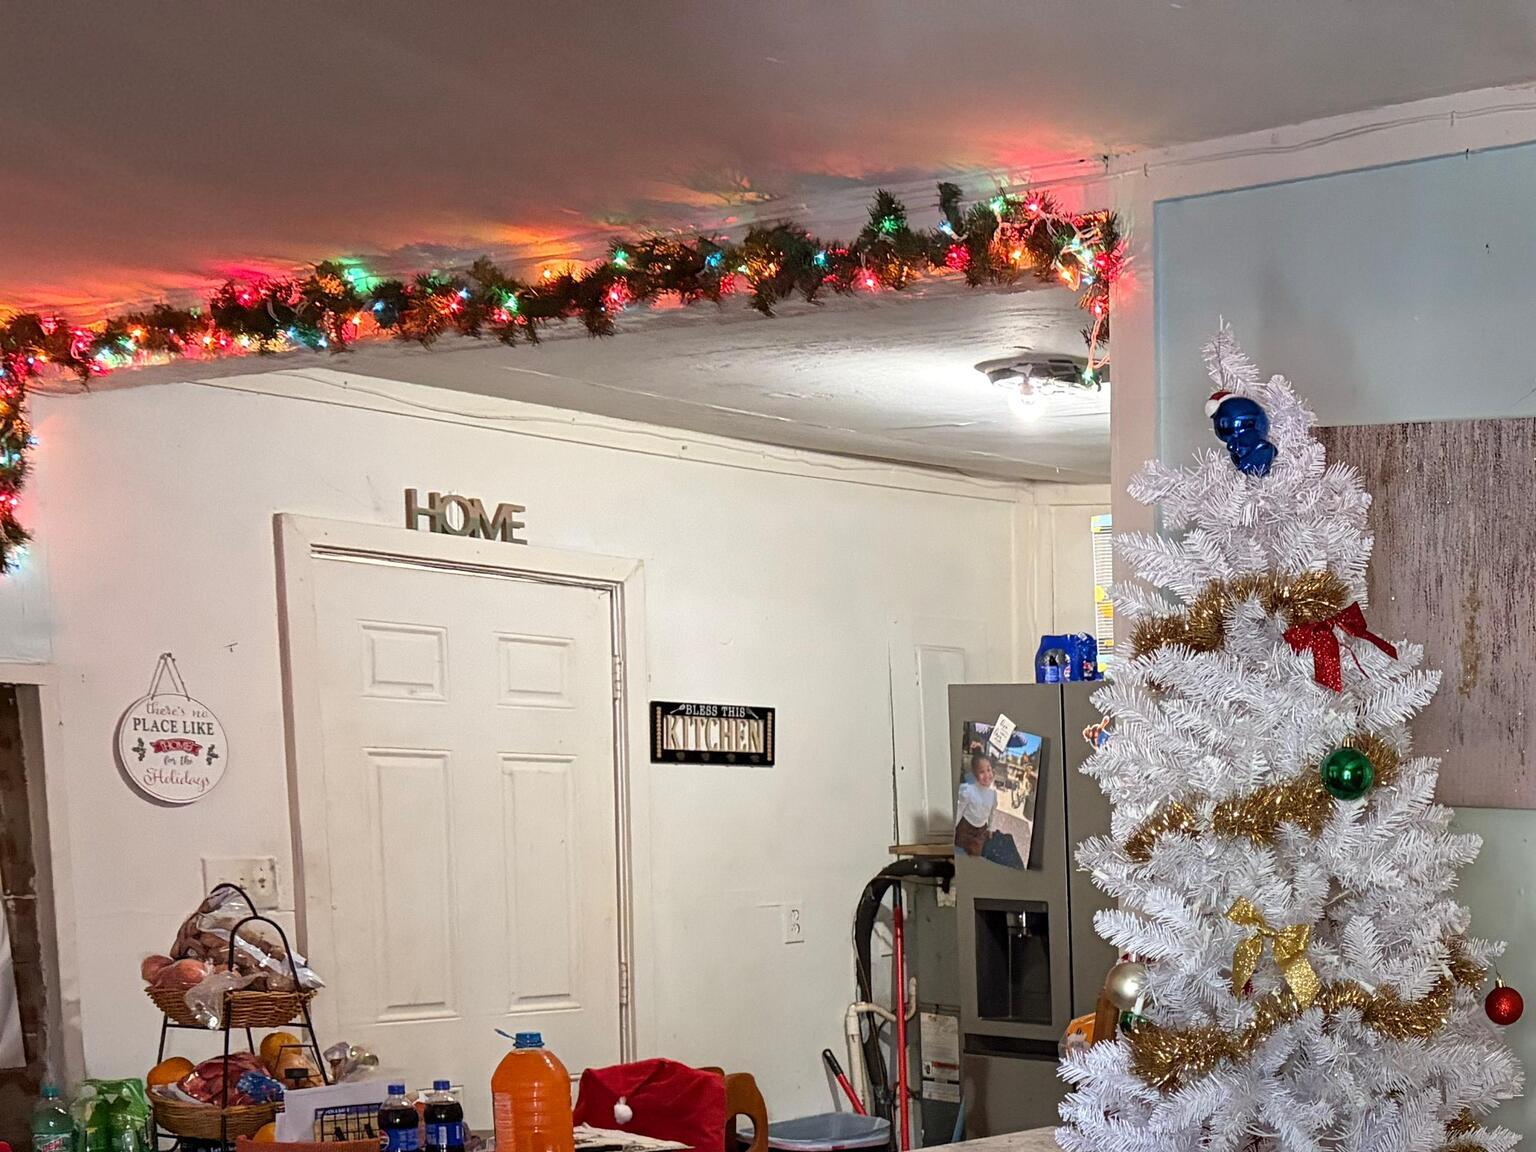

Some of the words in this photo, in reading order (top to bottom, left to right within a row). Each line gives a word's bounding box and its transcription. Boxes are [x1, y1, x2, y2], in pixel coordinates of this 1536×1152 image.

[404, 488, 528, 545] HOME
[685, 704, 718, 717] BLESS
[721, 706, 746, 718] THIS
[132, 717, 178, 733] PLACE
[183, 721, 214, 735] LIKE
[663, 715, 764, 753] KITCHEN
[143, 767, 211, 793] Holidays
